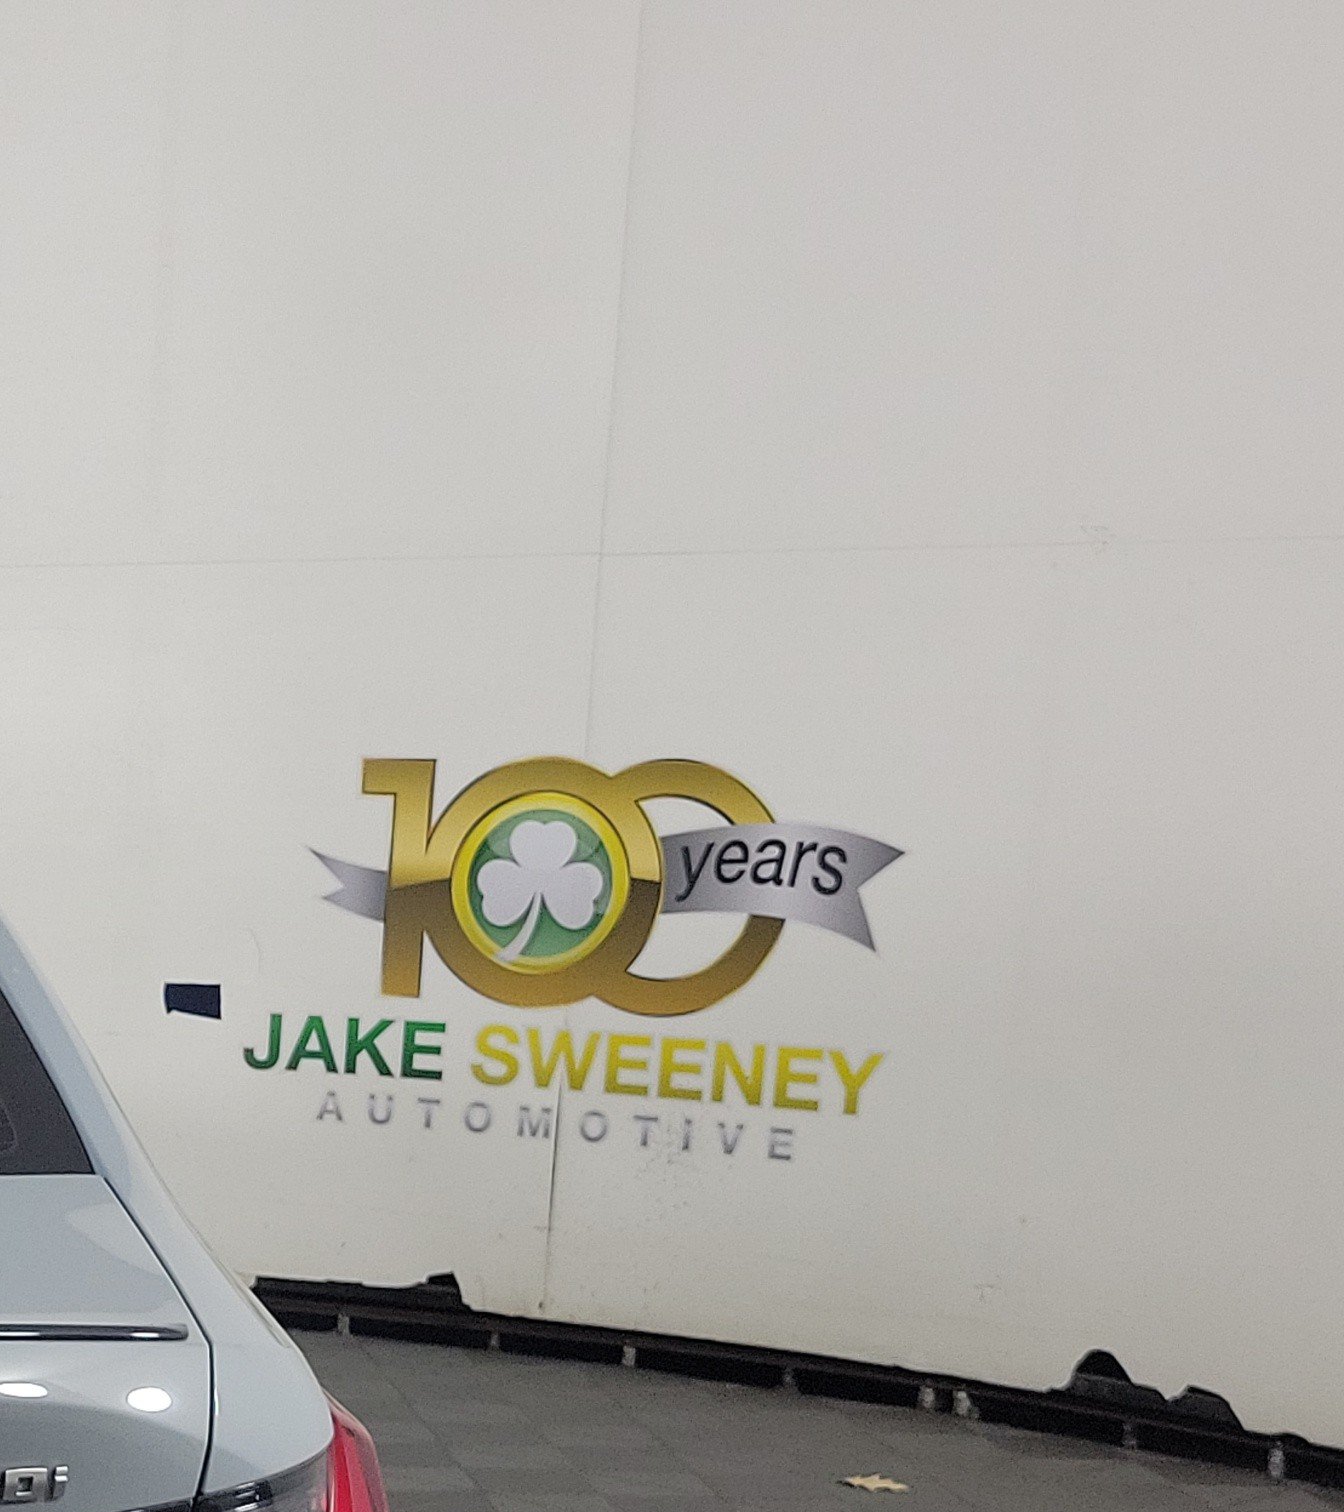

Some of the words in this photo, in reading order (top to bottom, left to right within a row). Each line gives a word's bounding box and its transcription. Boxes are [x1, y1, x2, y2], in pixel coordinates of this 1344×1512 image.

[361, 756, 786, 1017] 100
[676, 834, 848, 903] years
[242, 1012, 446, 1080] JAKE
[470, 1023, 885, 1115] SWEENEY
[316, 1090, 796, 1161] AUTOMOTIVE
